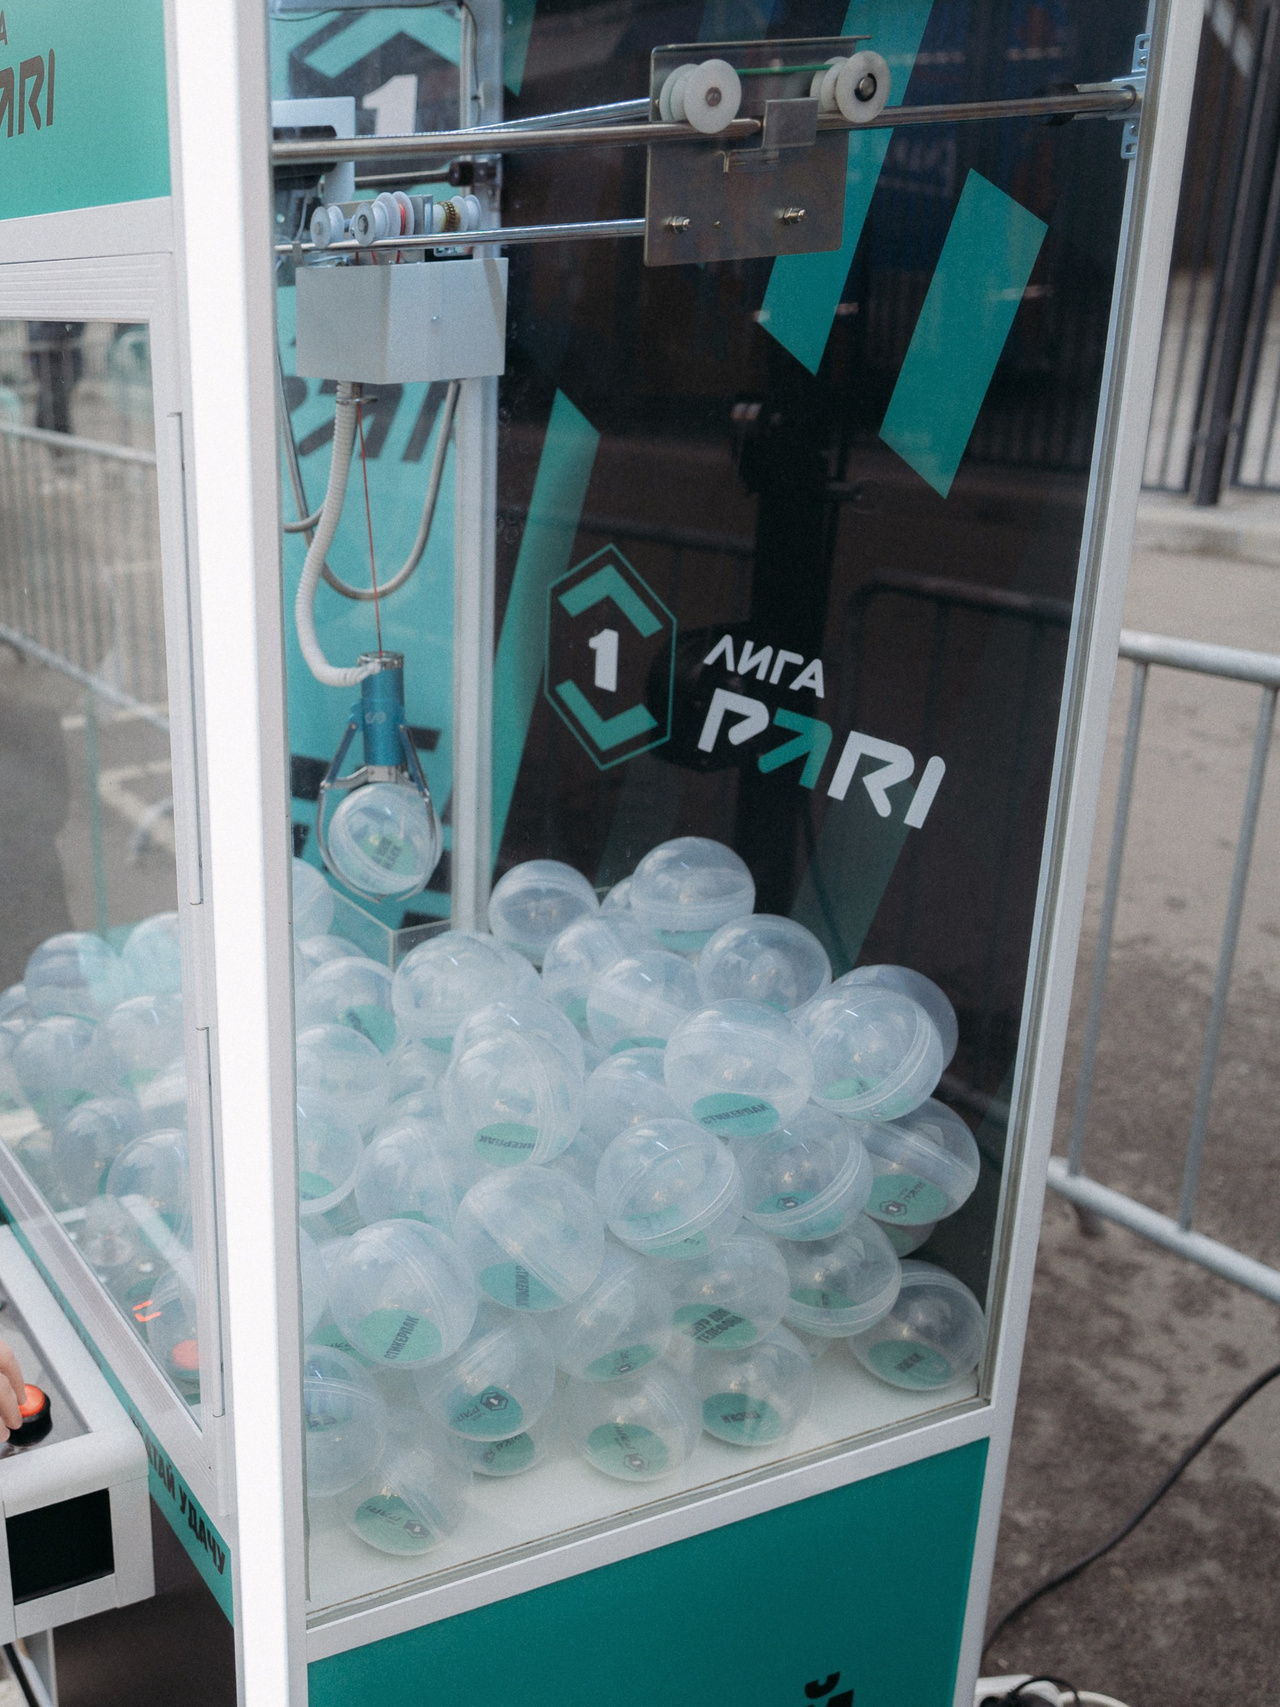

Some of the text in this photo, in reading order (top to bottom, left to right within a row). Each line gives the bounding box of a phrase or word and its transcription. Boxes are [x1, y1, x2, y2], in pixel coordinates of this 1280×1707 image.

[588, 628, 620, 693] 1
[703, 634, 825, 699] ЛИГА
[478, 1135, 536, 1150] ИКЕРПАК
[383, 1314, 420, 1360] СТИКЕРПАК
[179, 1484, 226, 1576] УДАЧУ
